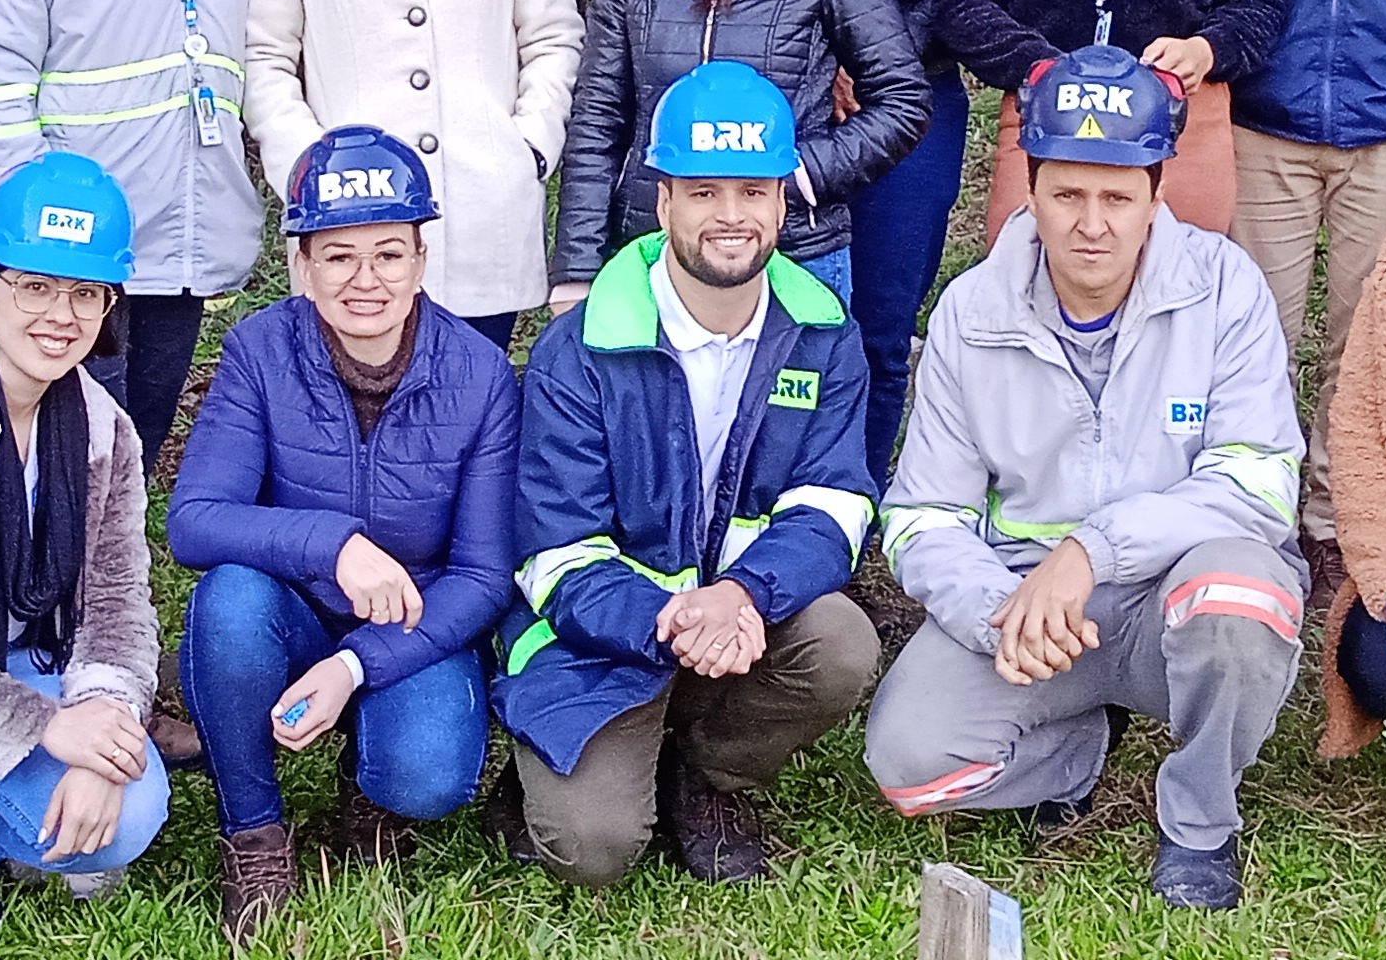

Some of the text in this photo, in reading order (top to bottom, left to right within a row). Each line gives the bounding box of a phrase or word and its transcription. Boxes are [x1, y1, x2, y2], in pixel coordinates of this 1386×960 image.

[1057, 84, 1133, 117] BRK
[691, 122, 766, 152] BRK
[318, 169, 395, 202] BRK
[47, 213, 85, 231] BRK
[1171, 403, 1203, 422] BR
